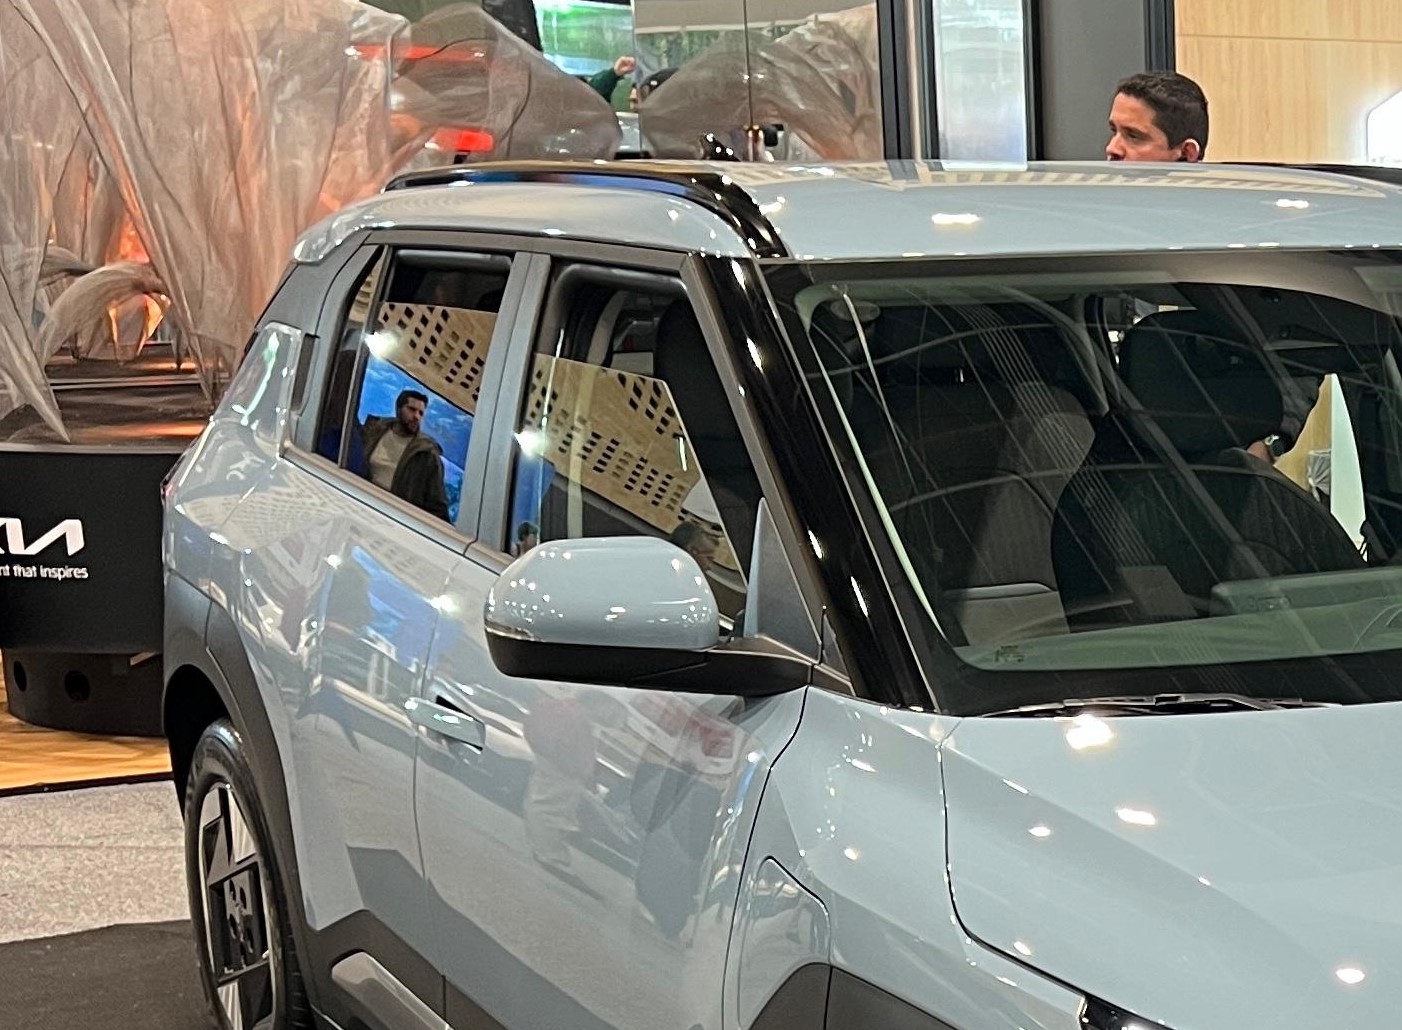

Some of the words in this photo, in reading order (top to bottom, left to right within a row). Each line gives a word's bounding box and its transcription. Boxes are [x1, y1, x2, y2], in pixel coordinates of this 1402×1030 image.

[0, 517, 85, 556] IA
[13, 564, 37, 578] that
[40, 565, 89, 581] inspires
